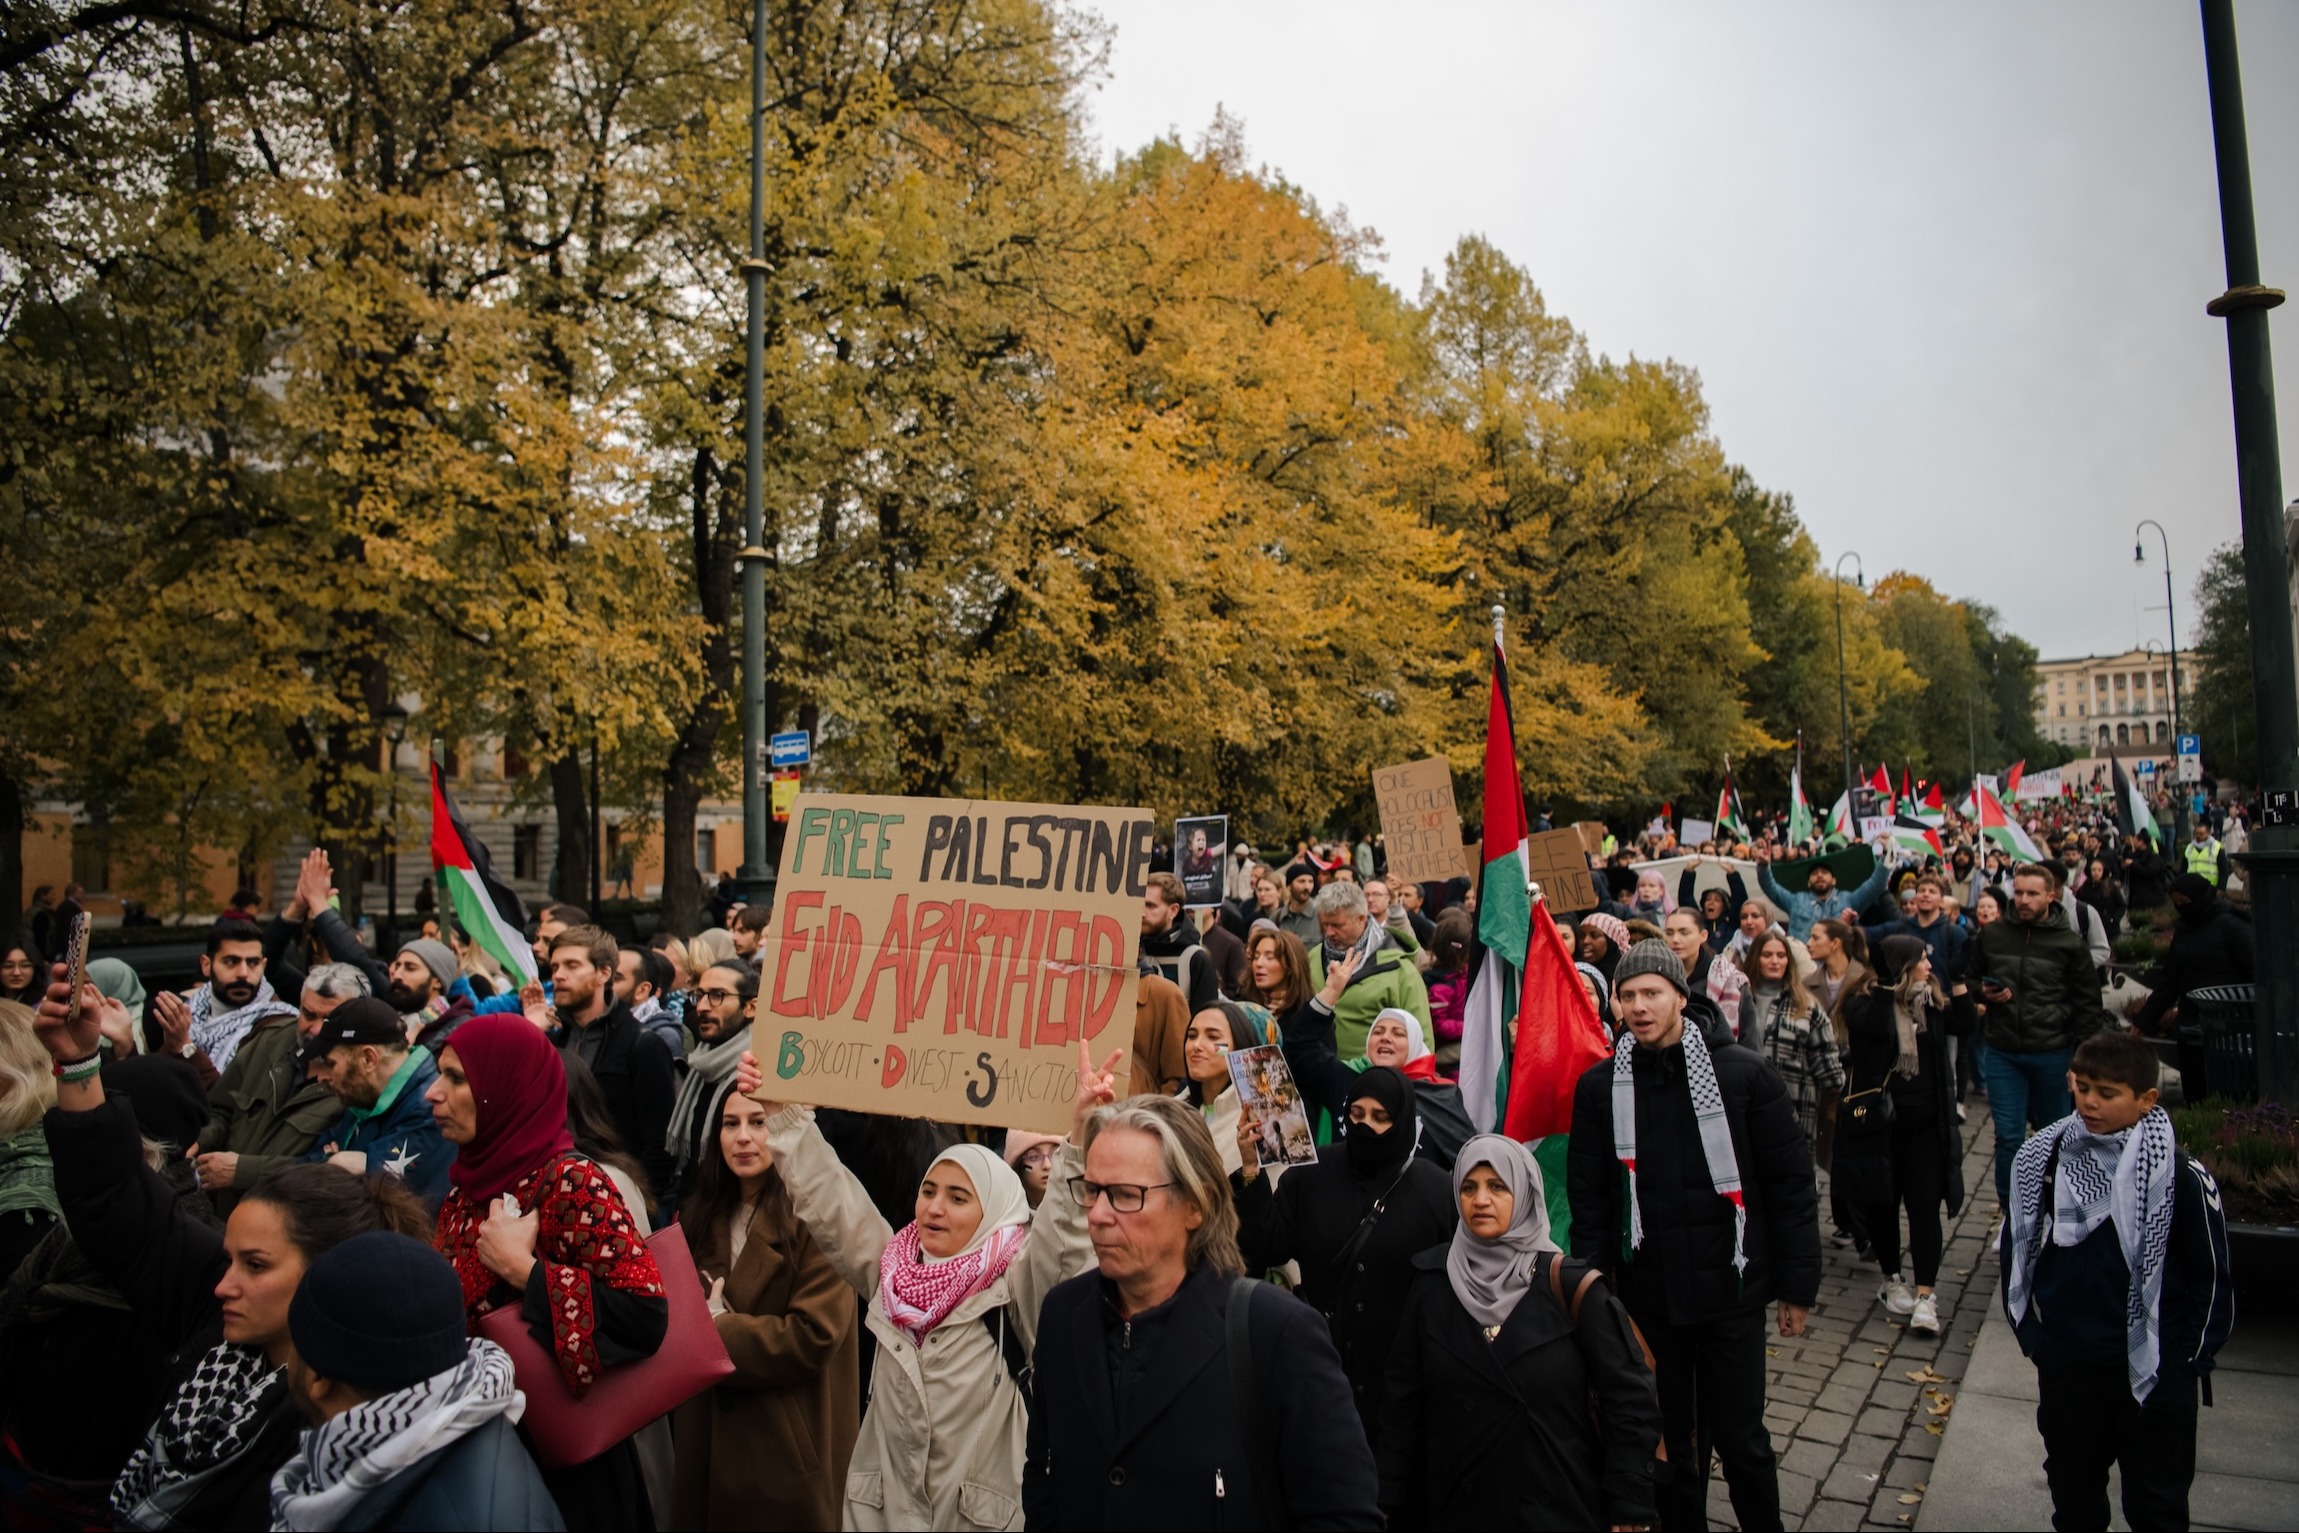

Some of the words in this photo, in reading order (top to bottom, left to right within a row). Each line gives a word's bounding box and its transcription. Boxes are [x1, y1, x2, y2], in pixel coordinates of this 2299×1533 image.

[2183, 737, 2194, 752] P
[1380, 771, 1415, 792] ONE
[1379, 784, 1453, 817] HOLOCAUST
[1383, 816, 1416, 835] DOES
[1422, 810, 1447, 827] NOT
[792, 808, 904, 879] FREE
[919, 815, 1154, 898] PALESTINE
[1386, 825, 1445, 856] JUSTIFY
[1392, 848, 1465, 878] ANOTHER
[770, 891, 862, 1020] END
[853, 893, 1124, 1049] APARTHEID
[776, 1031, 872, 1080] BOYCOTT
[881, 1044, 965, 1092] DIVEST
[966, 1052, 1079, 1107] SANCTIO
